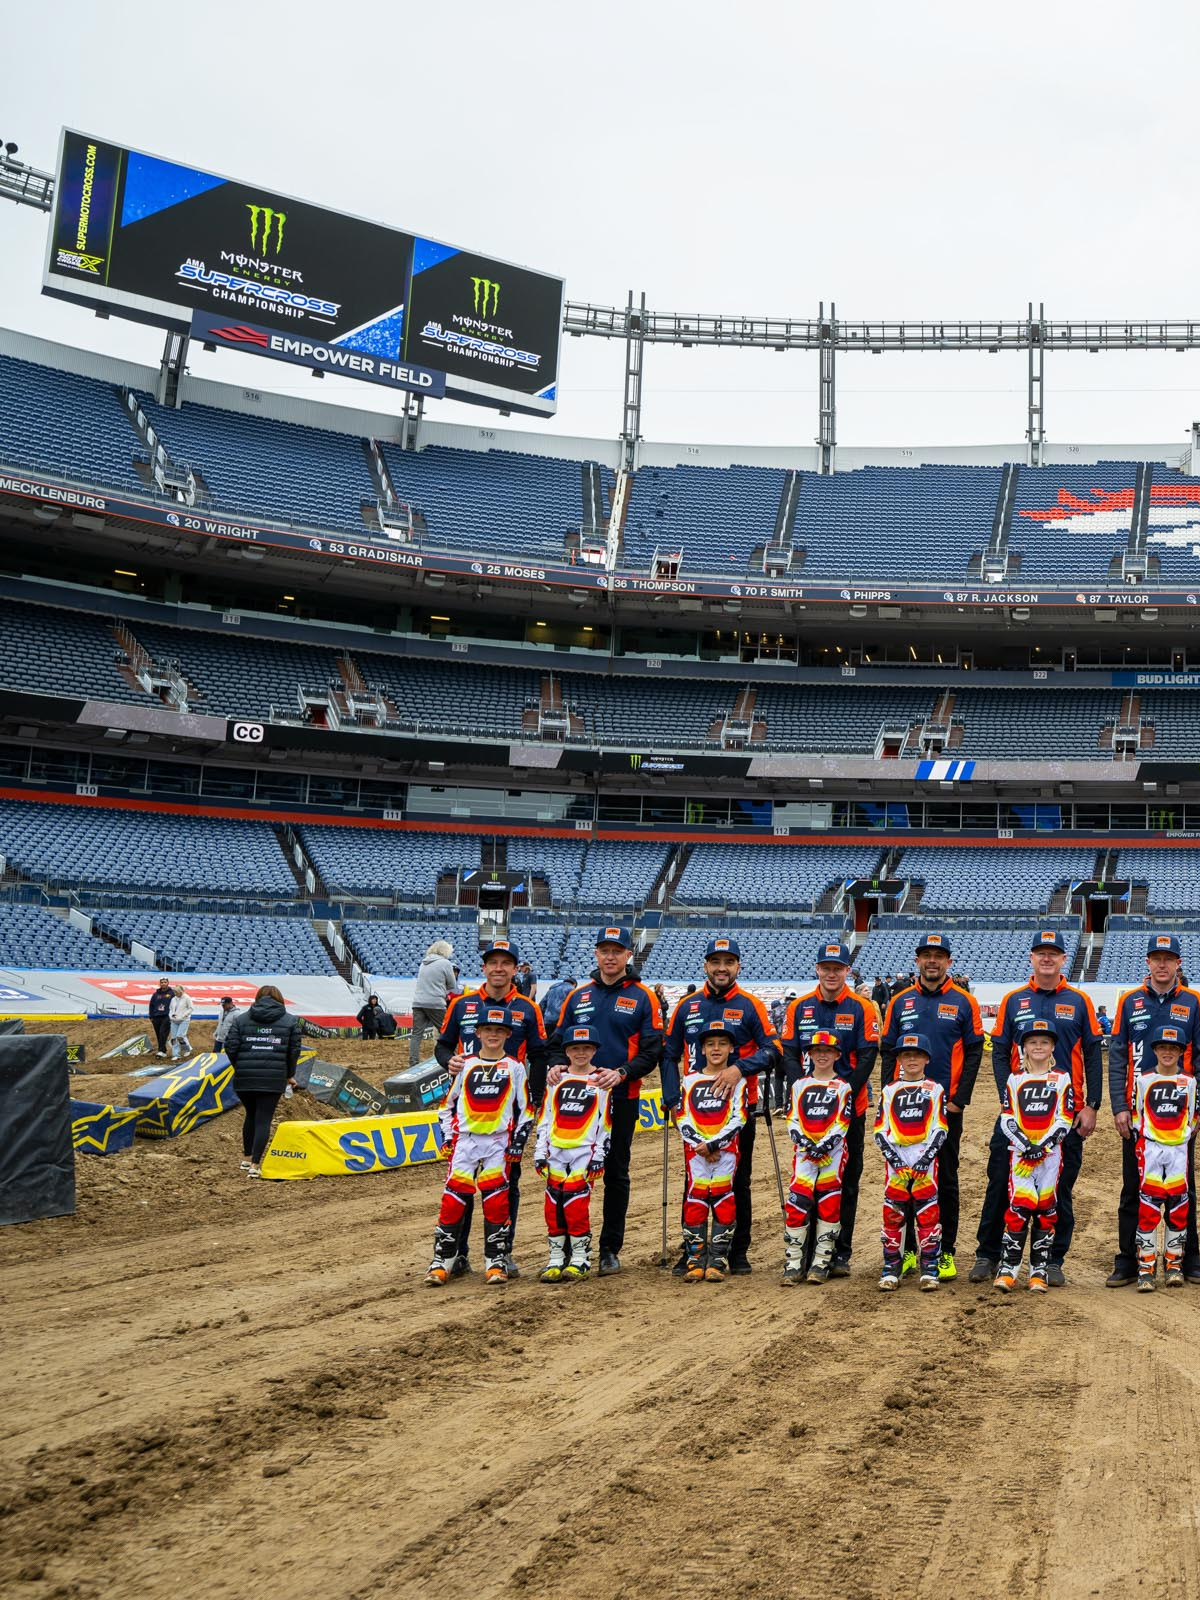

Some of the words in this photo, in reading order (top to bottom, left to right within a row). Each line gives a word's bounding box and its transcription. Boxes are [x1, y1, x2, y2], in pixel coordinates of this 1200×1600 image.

[76, 144, 97, 251] SUPERMOTOCROSS.COM
[185, 258, 205, 269] AMA
[220, 250, 304, 283] MONSTER
[233, 266, 291, 286] ENERGY
[174, 263, 342, 316] SUPERCROSS
[212, 288, 305, 319] CHAMPIONSHIP
[427, 321, 441, 331] AMA
[452, 314, 513, 339] MONSTER
[462, 327, 504, 341] ENERGY
[420, 325, 541, 365] SUPERCROSS
[270, 335, 375, 374] EMPOWER
[379, 362, 433, 387] FIELD
[447, 344, 515, 368] CHAMPIONSHIP
[0, 478, 106, 510] MECKLENBURG
[184, 518, 201, 529] 20
[205, 522, 260, 540] WRIGHT
[329, 543, 345, 554] 53
[348, 545, 423, 567] GRADISHAR
[487, 564, 501, 574] 25
[504, 566, 546, 580] MOSES
[614, 578, 627, 588] 36
[632, 580, 695, 593] THOMPSON
[745, 587, 757, 596] 70
[760, 588, 768, 597] P.
[771, 588, 803, 598] SMITH
[854, 591, 891, 600] PHIPPS
[956, 593, 969, 602] 87
[972, 593, 981, 602] R.
[983, 593, 1039, 603] JACKSON
[1089, 594, 1101, 603] 87
[1108, 594, 1149, 604] TAYLOR
[1137, 674, 1163, 685] BUD
[1164, 674, 1200, 685] LIGHT
[236, 726, 261, 740] CC
[79, 786, 96, 795] 110
[386, 811, 400, 819] 111
[775, 827, 788, 835] 112
[1000, 830, 1013, 838] 113
[310, 1072, 335, 1087] GoPro
[420, 1072, 450, 1093] GoP
[344, 1080, 382, 1111] GoPro
[474, 1085, 500, 1095] KTM
[1023, 1087, 1051, 1099] TLD
[1153, 1088, 1180, 1100] TLD
[697, 1099, 722, 1109] KTM
[806, 1092, 833, 1104] TLD
[898, 1094, 925, 1106] TLD
[560, 1102, 585, 1113] KTM
[807, 1106, 828, 1116] KTM
[900, 1108, 923, 1118] KTM
[1025, 1102, 1049, 1112] KTM
[1157, 1103, 1178, 1113] KTM
[339, 1122, 446, 1171] SUZ
[270, 1149, 307, 1159] SUZUKI
